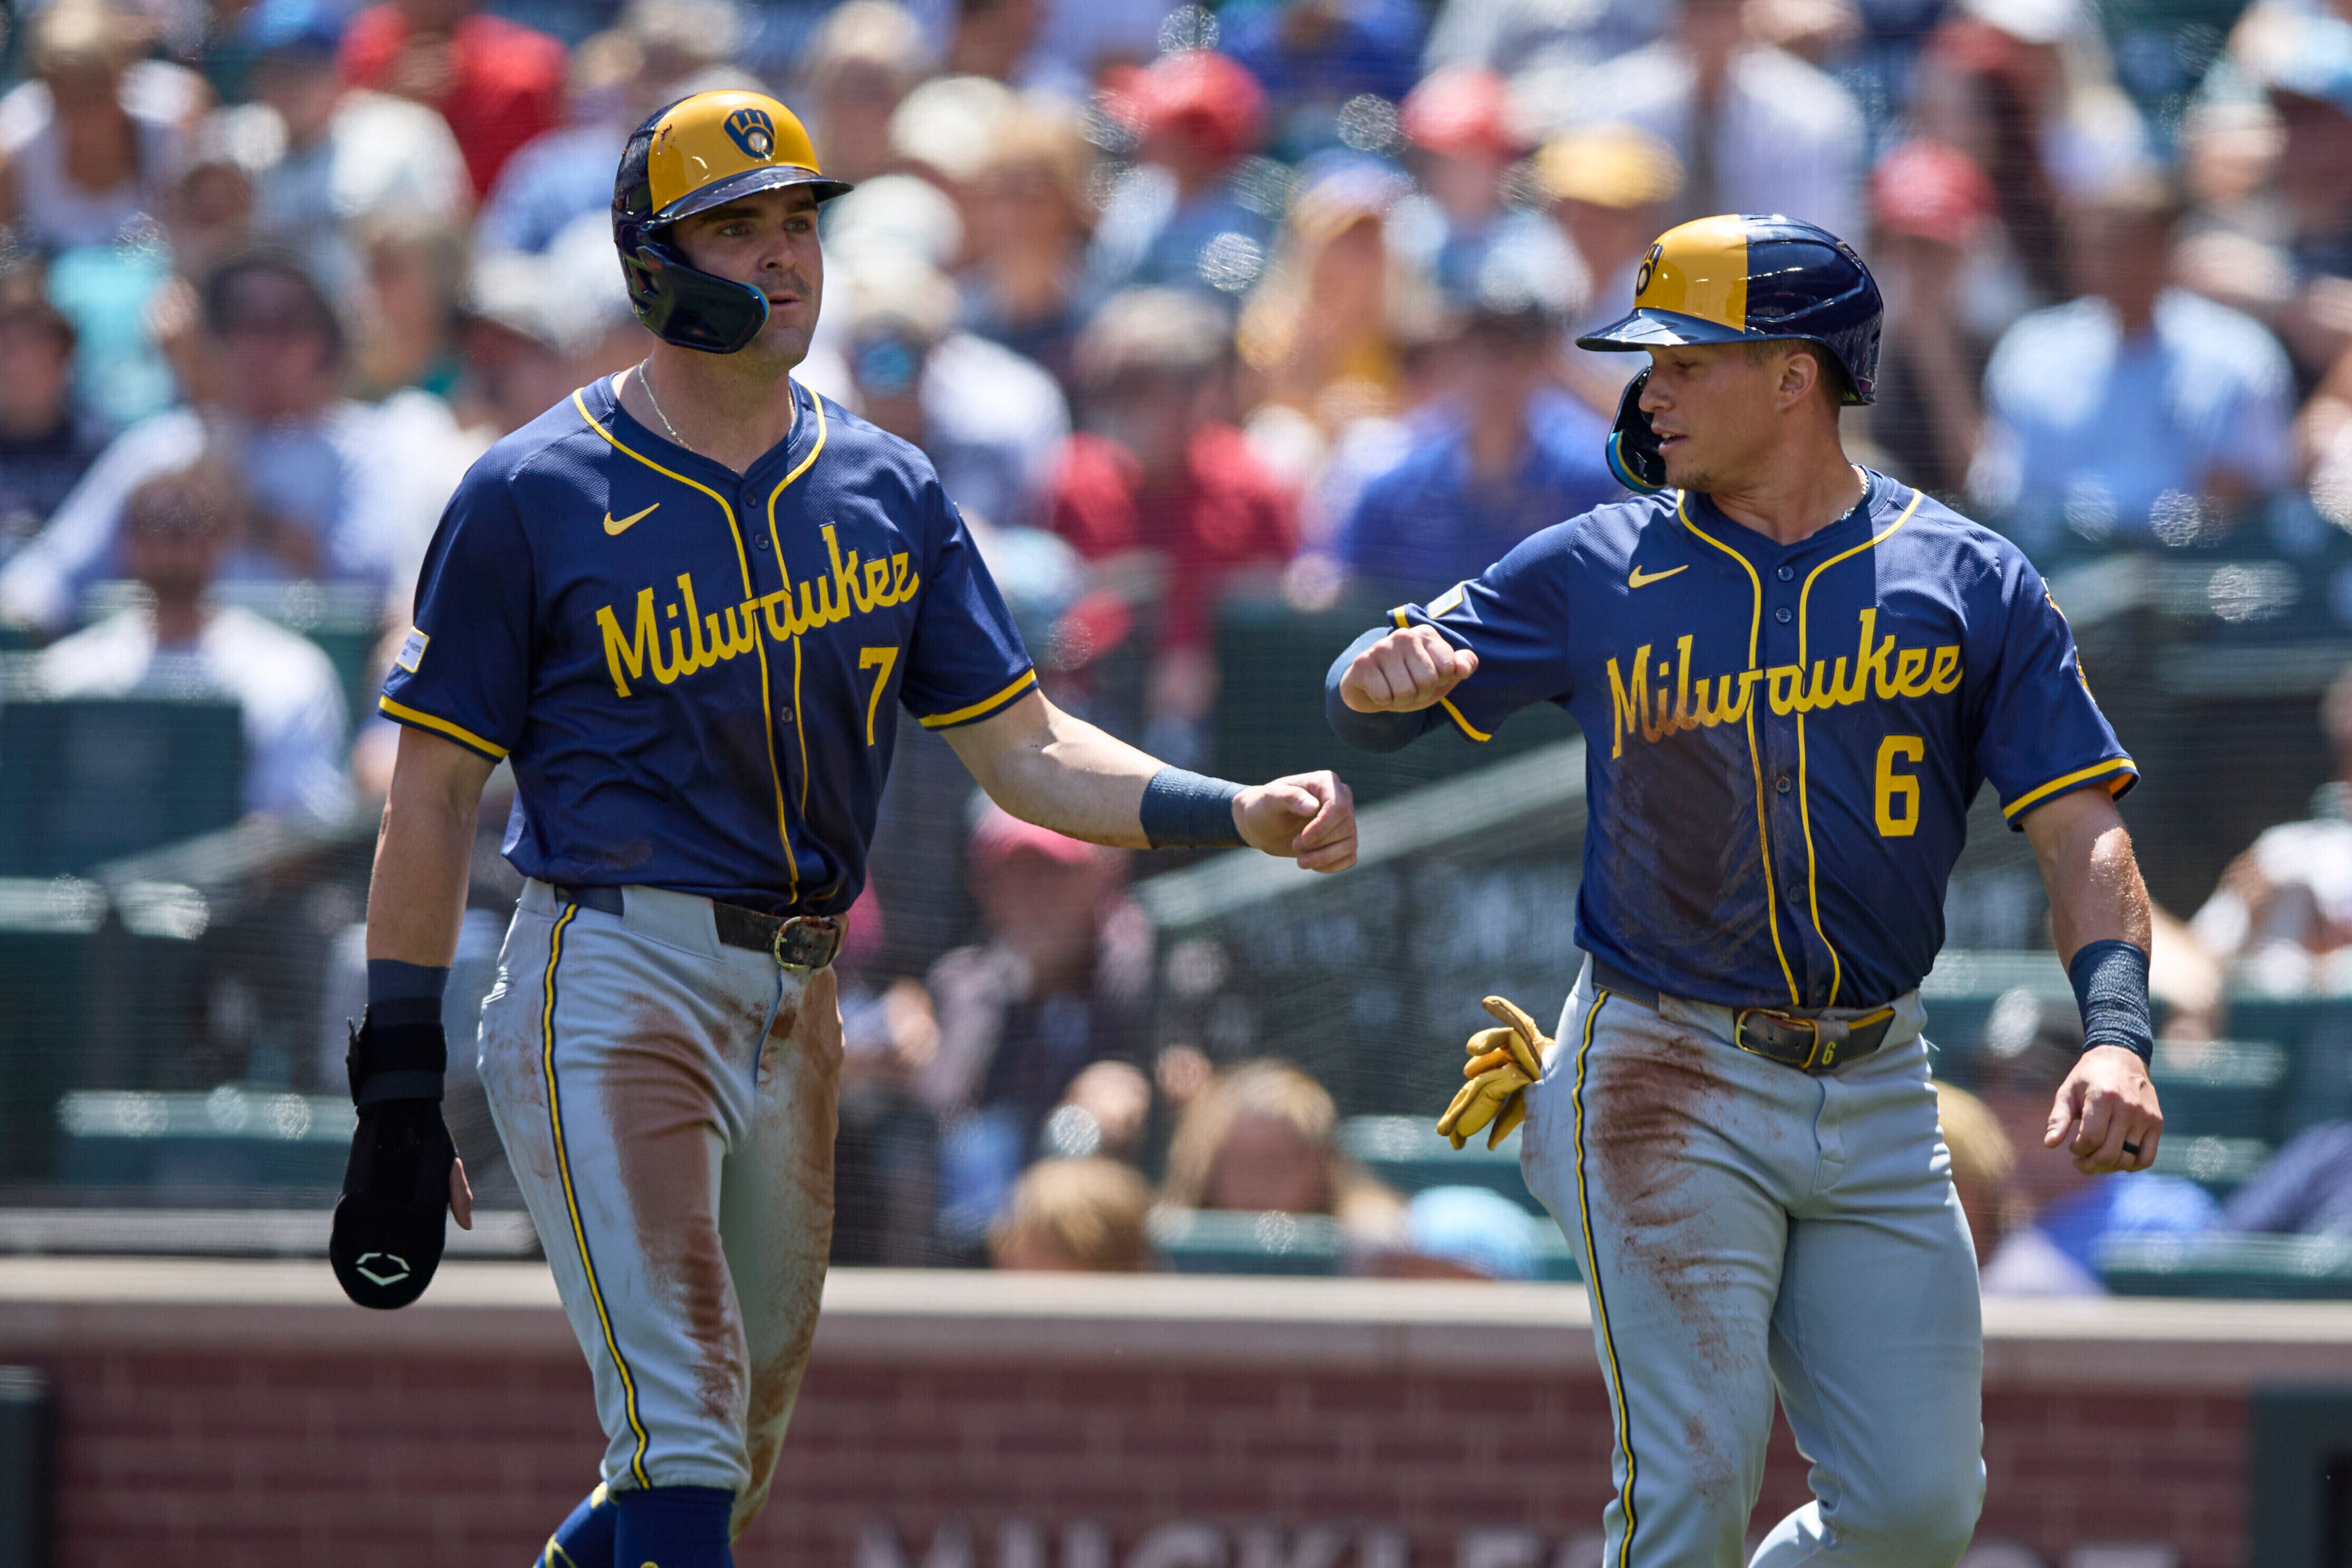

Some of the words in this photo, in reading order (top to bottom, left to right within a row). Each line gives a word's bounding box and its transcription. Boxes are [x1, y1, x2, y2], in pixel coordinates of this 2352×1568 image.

[596, 524, 919, 697] Milwaukee
[859, 646, 898, 746] 7
[1606, 607, 1963, 759] Milwaukee
[1874, 735, 1924, 836] 6
[1822, 1041, 1836, 1064] 6
